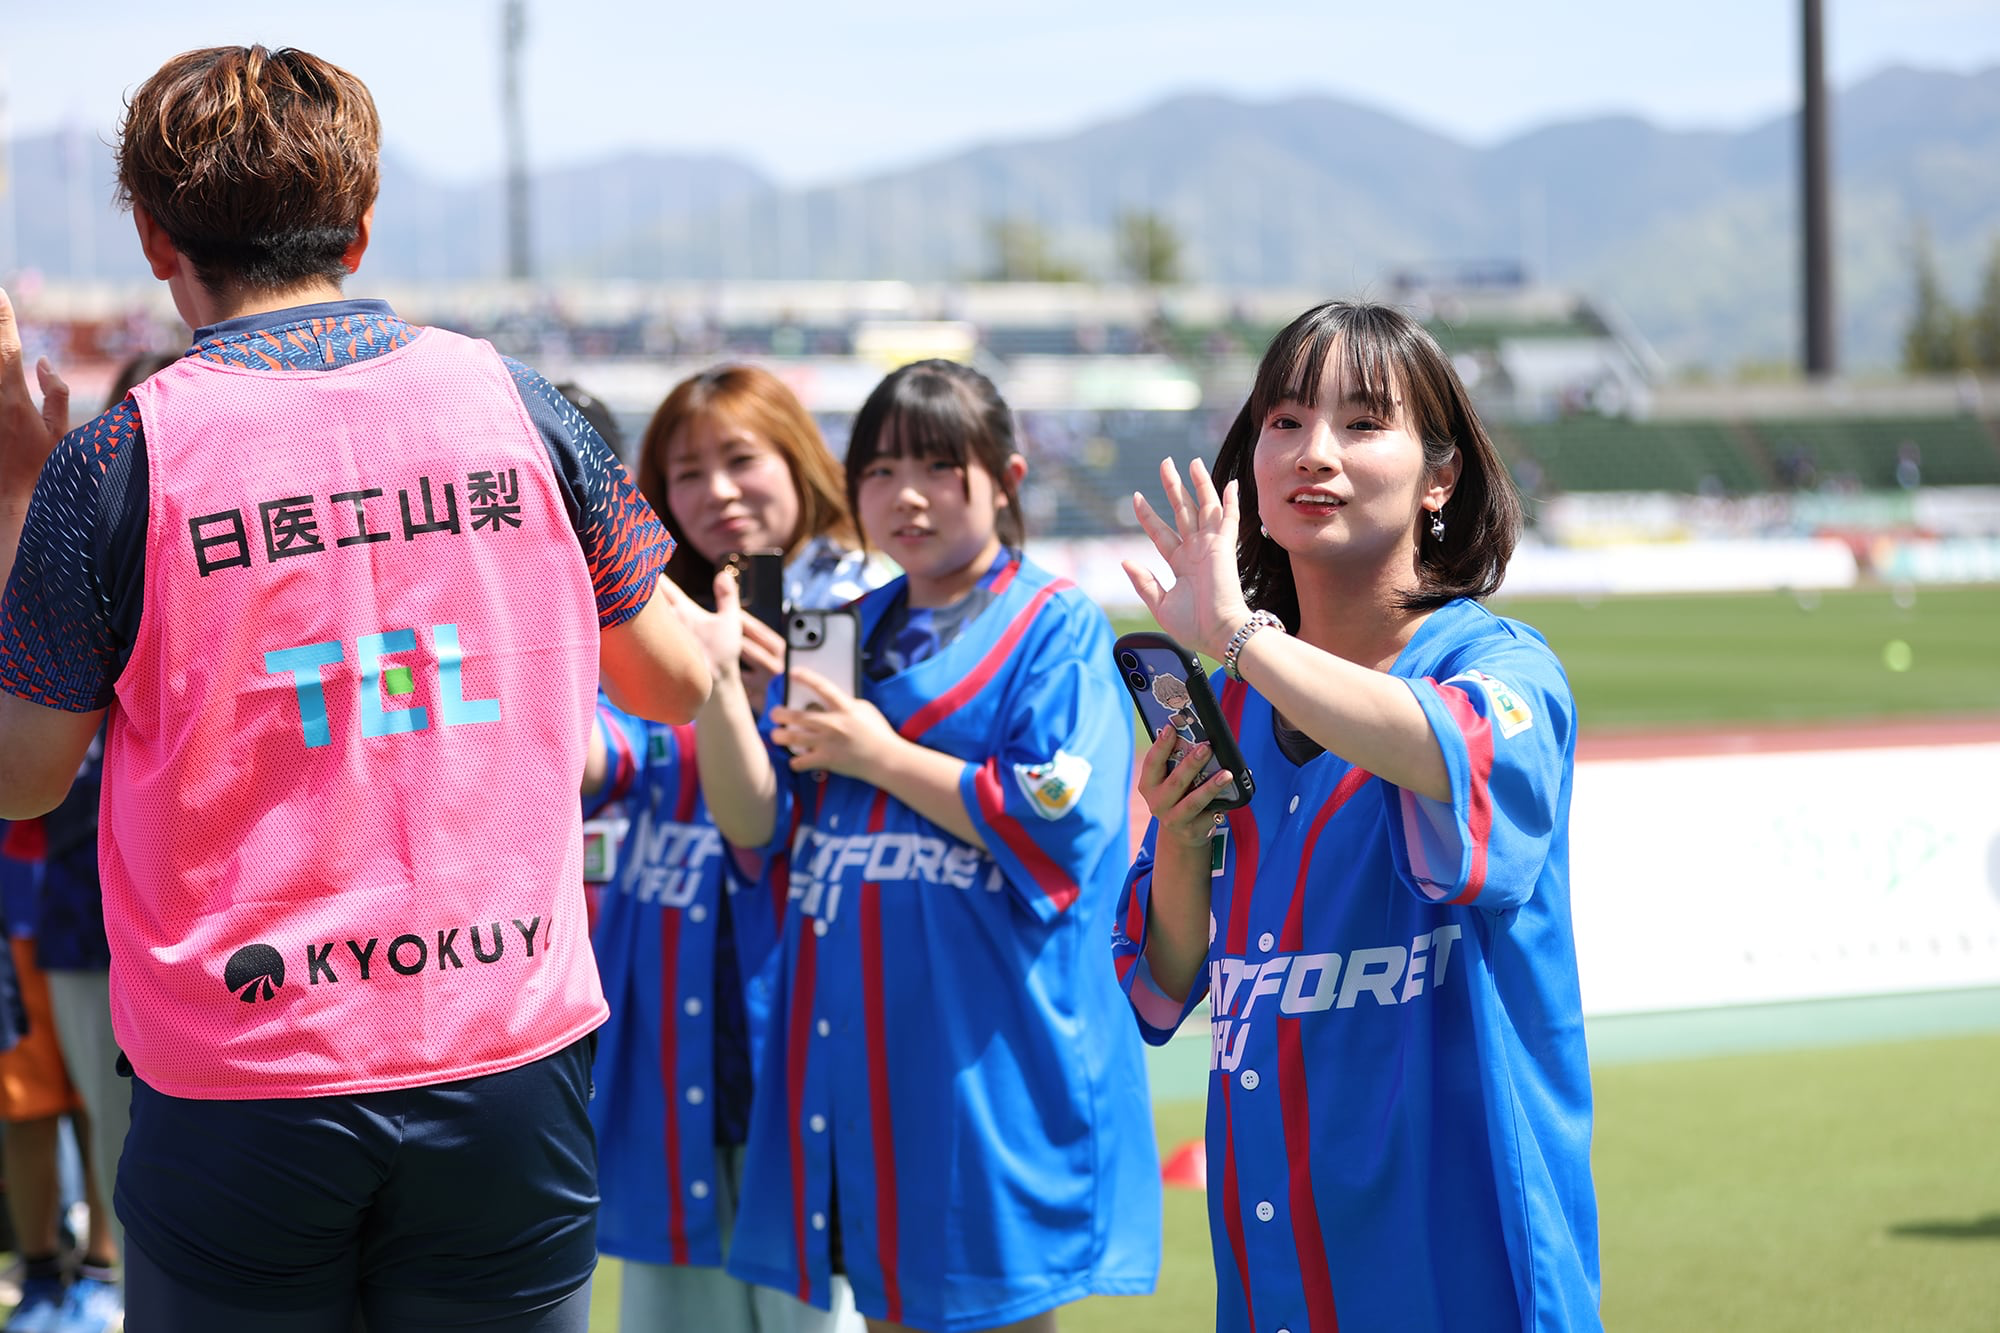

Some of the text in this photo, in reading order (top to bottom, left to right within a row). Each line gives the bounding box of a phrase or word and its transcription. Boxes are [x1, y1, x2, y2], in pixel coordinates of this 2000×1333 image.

[188, 468, 522, 577] 日医工山梨
[264, 624, 500, 748] TEL
[307, 916, 553, 985] KYOKUY
[1208, 924, 1462, 1019] NTFORET
